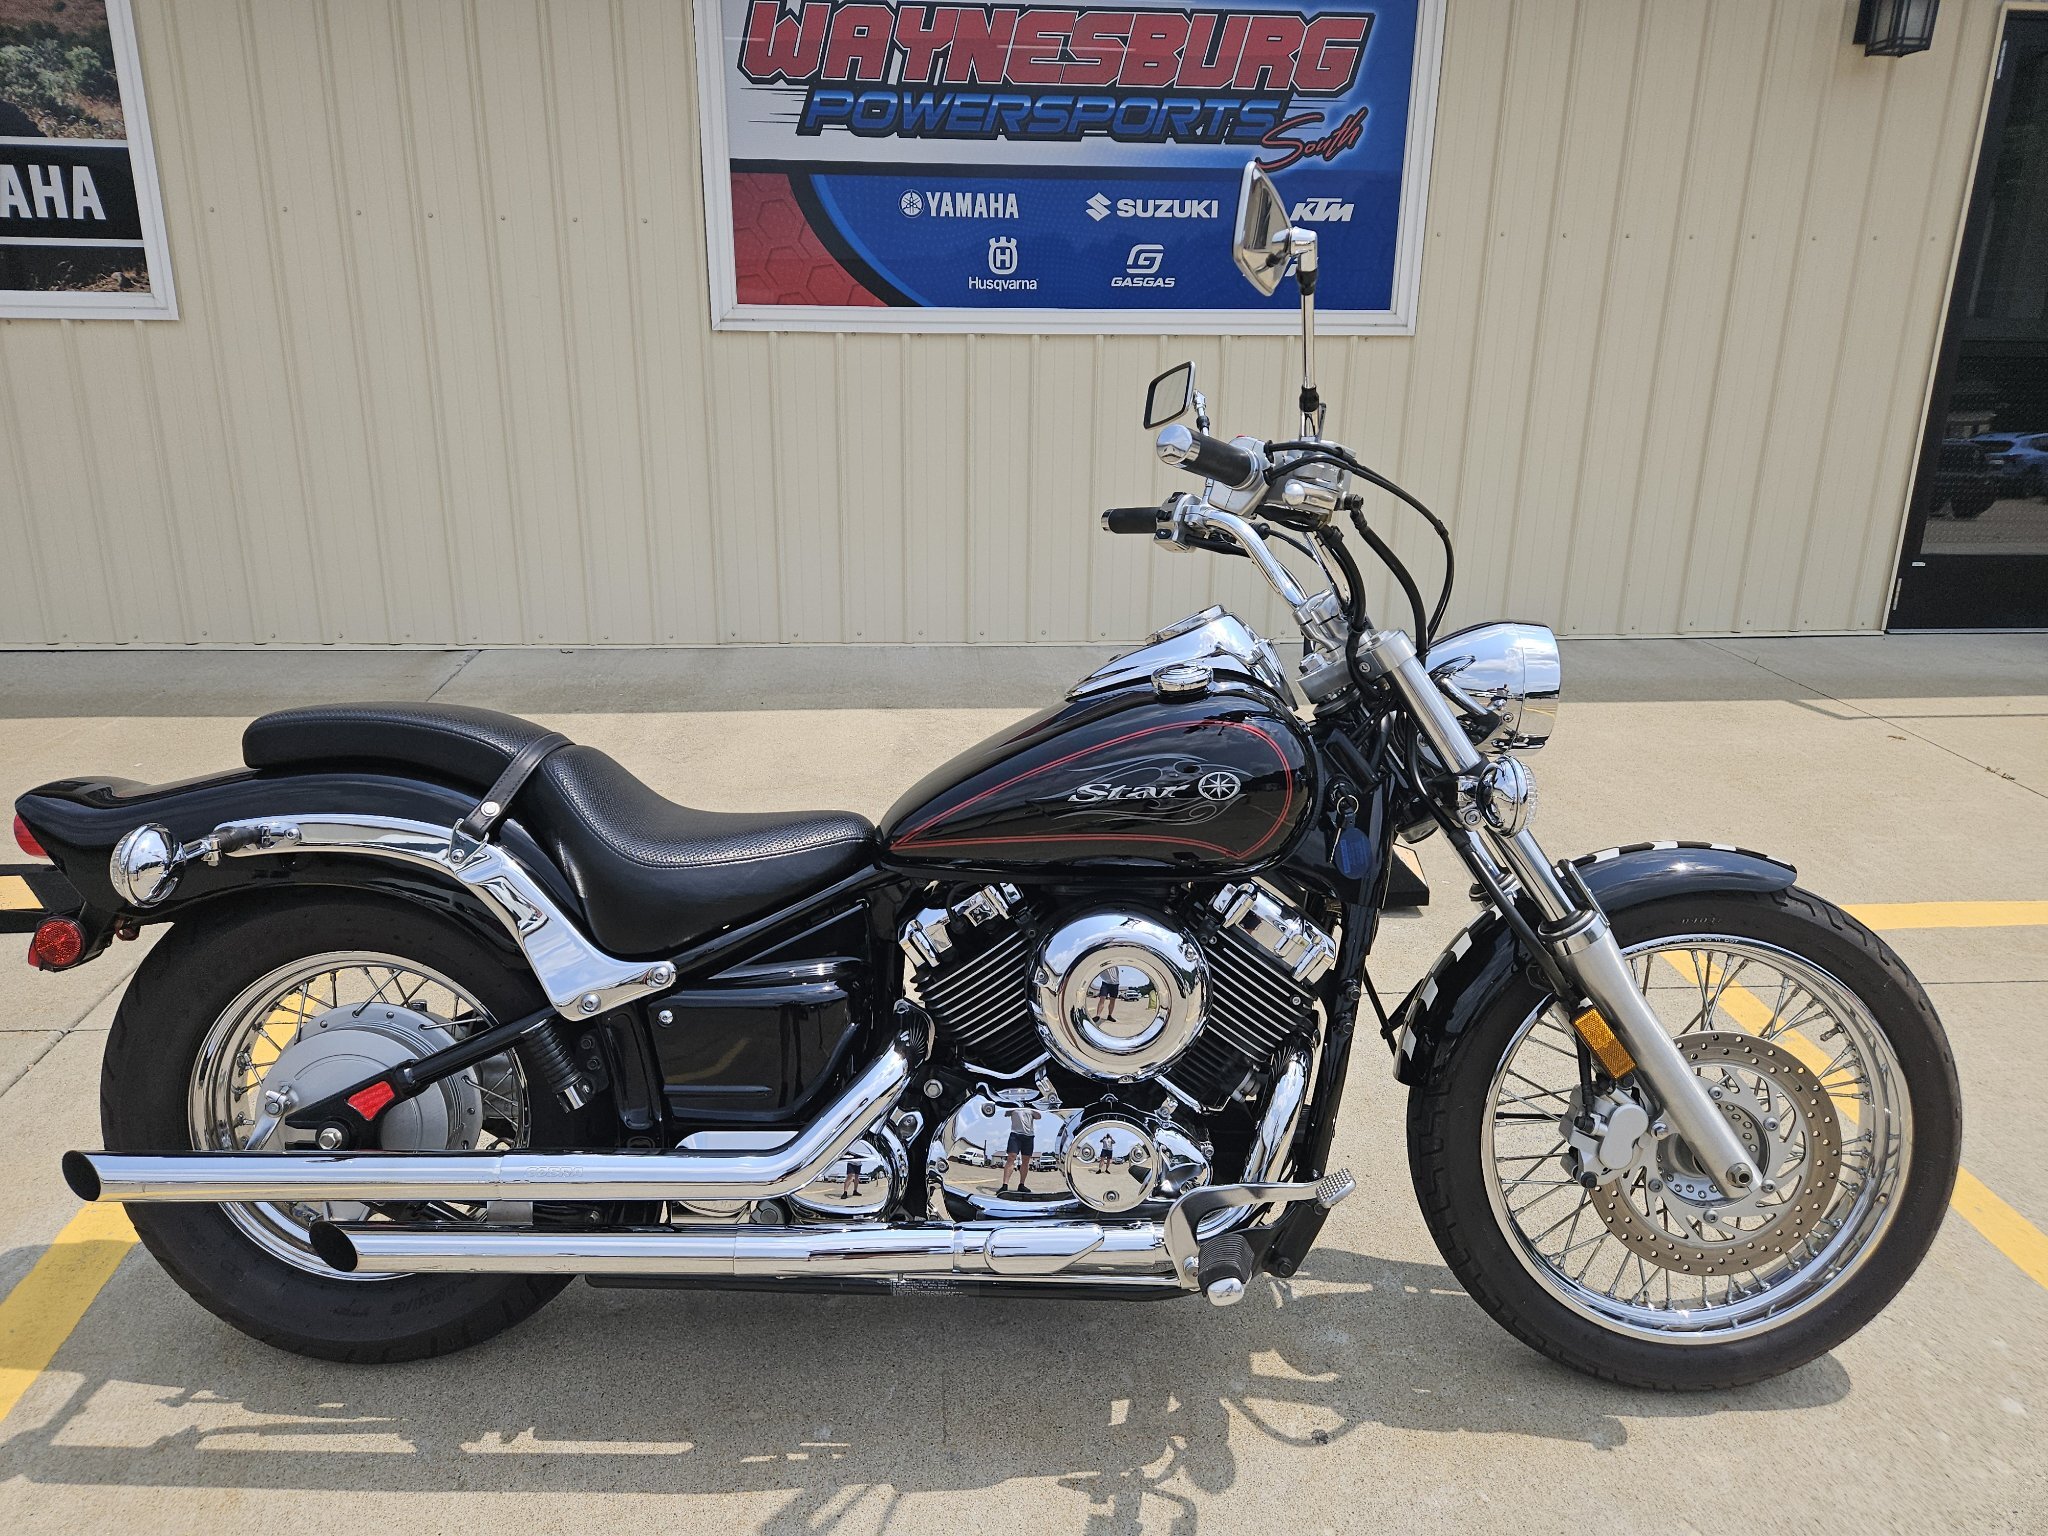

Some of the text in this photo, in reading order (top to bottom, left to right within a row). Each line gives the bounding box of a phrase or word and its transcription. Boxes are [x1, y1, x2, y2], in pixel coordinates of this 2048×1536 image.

[739, 1, 1373, 94] WAYNESBURG
[801, 88, 1281, 139] POWERSPORTS
[1256, 107, 1367, 170] South
[926, 191, 1019, 219] YAMAHA
[1116, 198, 1219, 219] SUZUKI
[1290, 198, 1354, 222] KTM
[968, 276, 1037, 291] Husqvarna
[1110, 277, 1176, 288] GASGAS
[1068, 783, 1190, 802] Star
